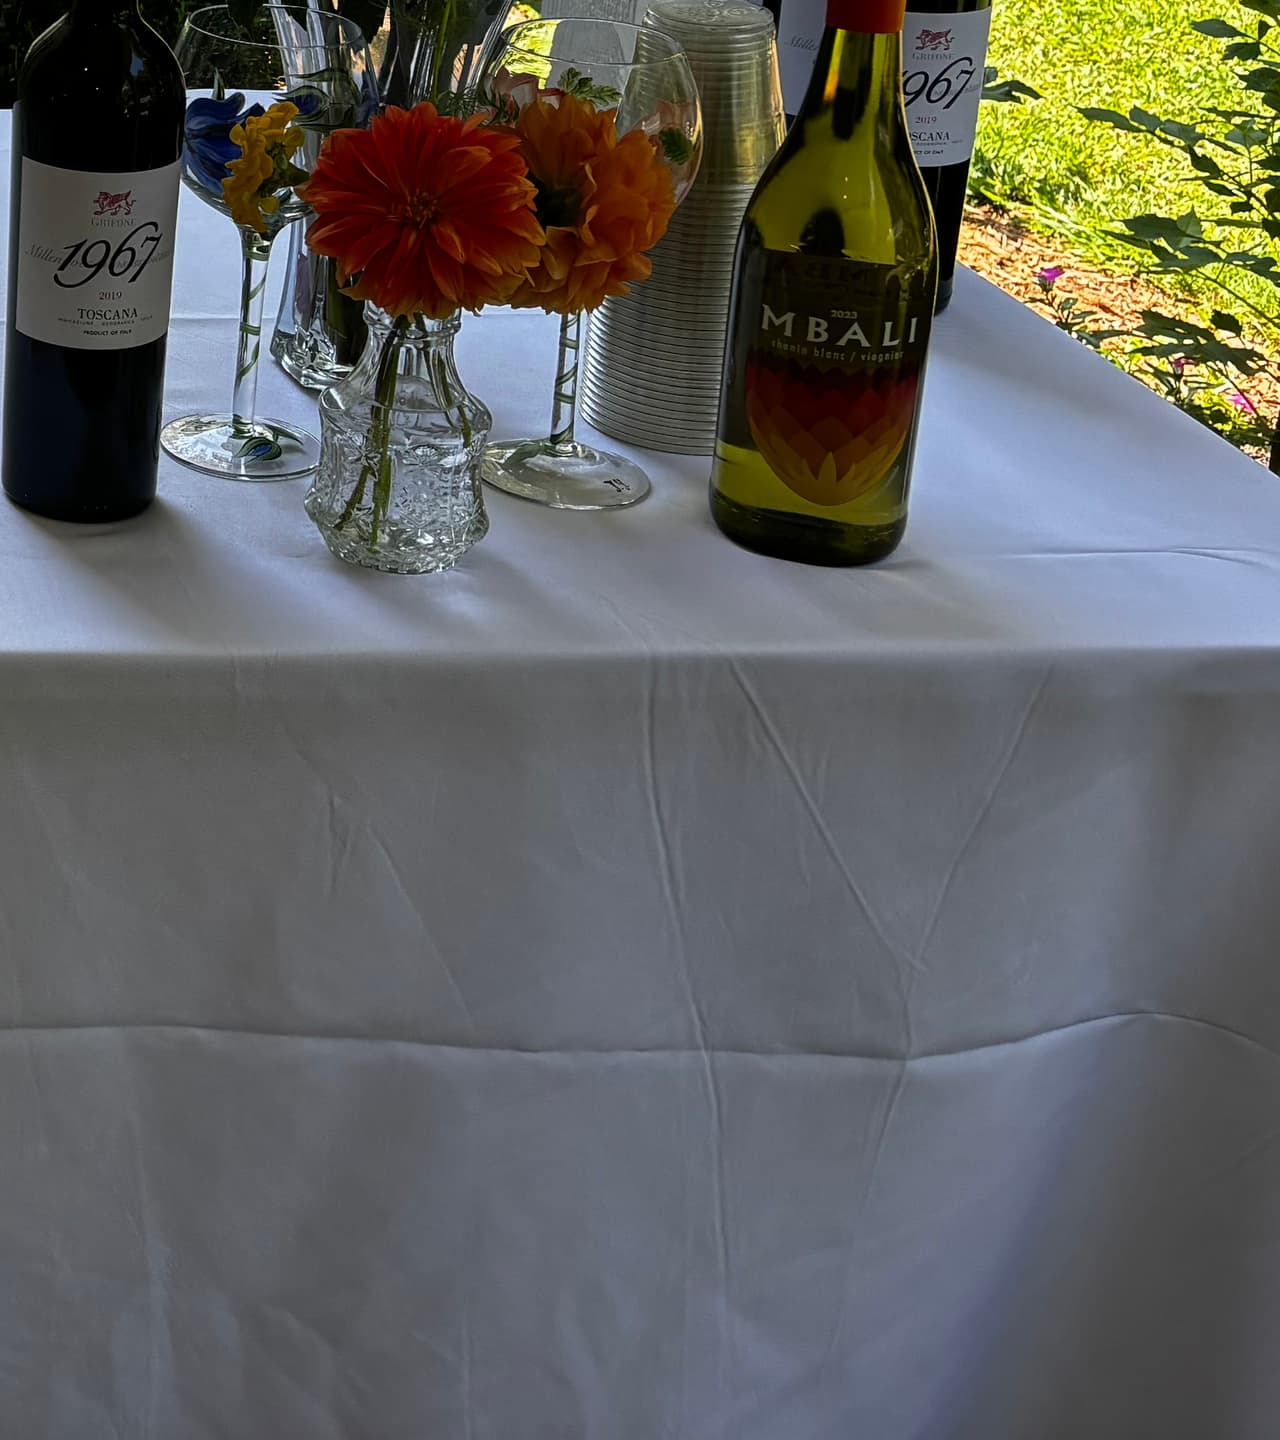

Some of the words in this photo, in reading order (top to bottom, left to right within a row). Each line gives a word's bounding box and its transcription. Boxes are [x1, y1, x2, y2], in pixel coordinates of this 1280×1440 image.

[902, 57, 976, 110] 967
[53, 221, 163, 289] 1967
[98, 291, 123, 301] 2019
[77, 307, 139, 322] TOSCANA
[831, 310, 858, 319] 2023
[761, 303, 918, 348] MBALI
[814, 345, 846, 361] blanc
